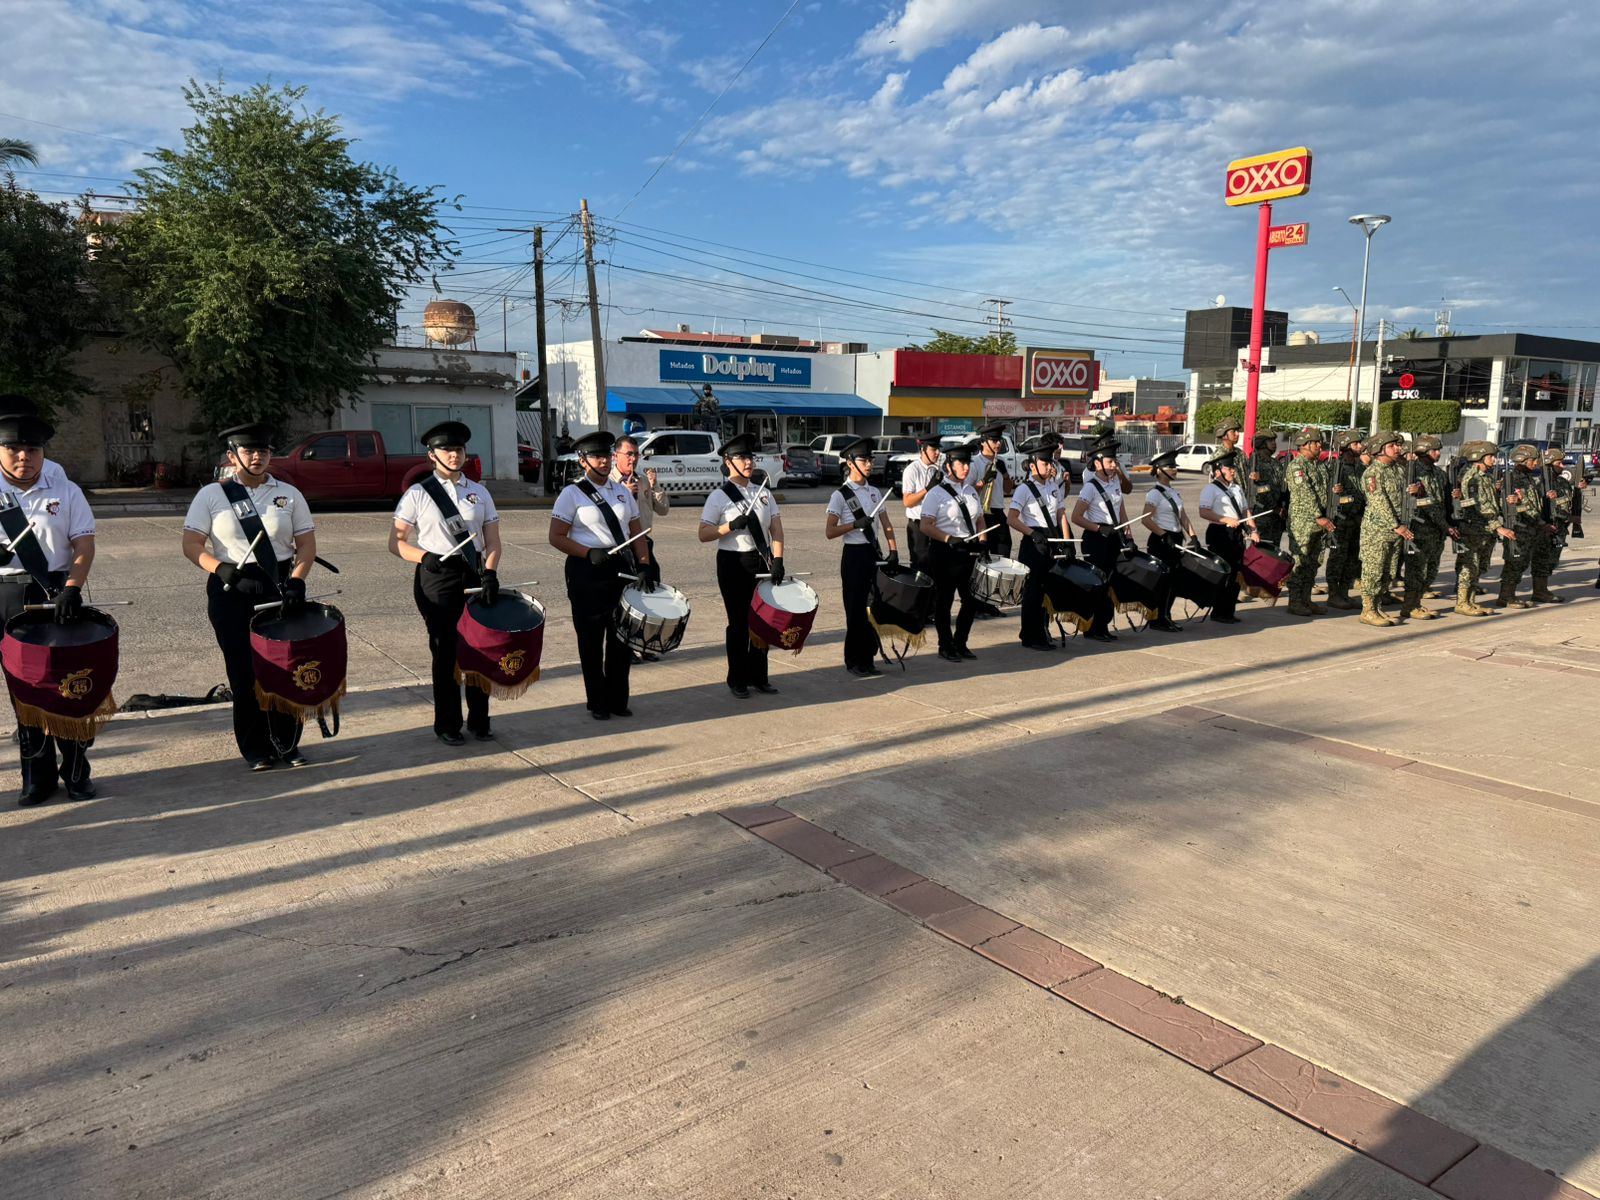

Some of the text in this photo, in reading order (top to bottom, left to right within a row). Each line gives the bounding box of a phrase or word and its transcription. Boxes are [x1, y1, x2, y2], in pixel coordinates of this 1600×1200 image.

[1228, 158, 1303, 196] OXXO
[1286, 225, 1303, 238] 24
[670, 361, 695, 370] Helados
[702, 354, 776, 382] Dolphy
[780, 367, 802, 375] Helados
[1035, 359, 1088, 387] OXXO
[643, 466, 673, 474] GARDIA
[73, 684, 87, 694] 45
